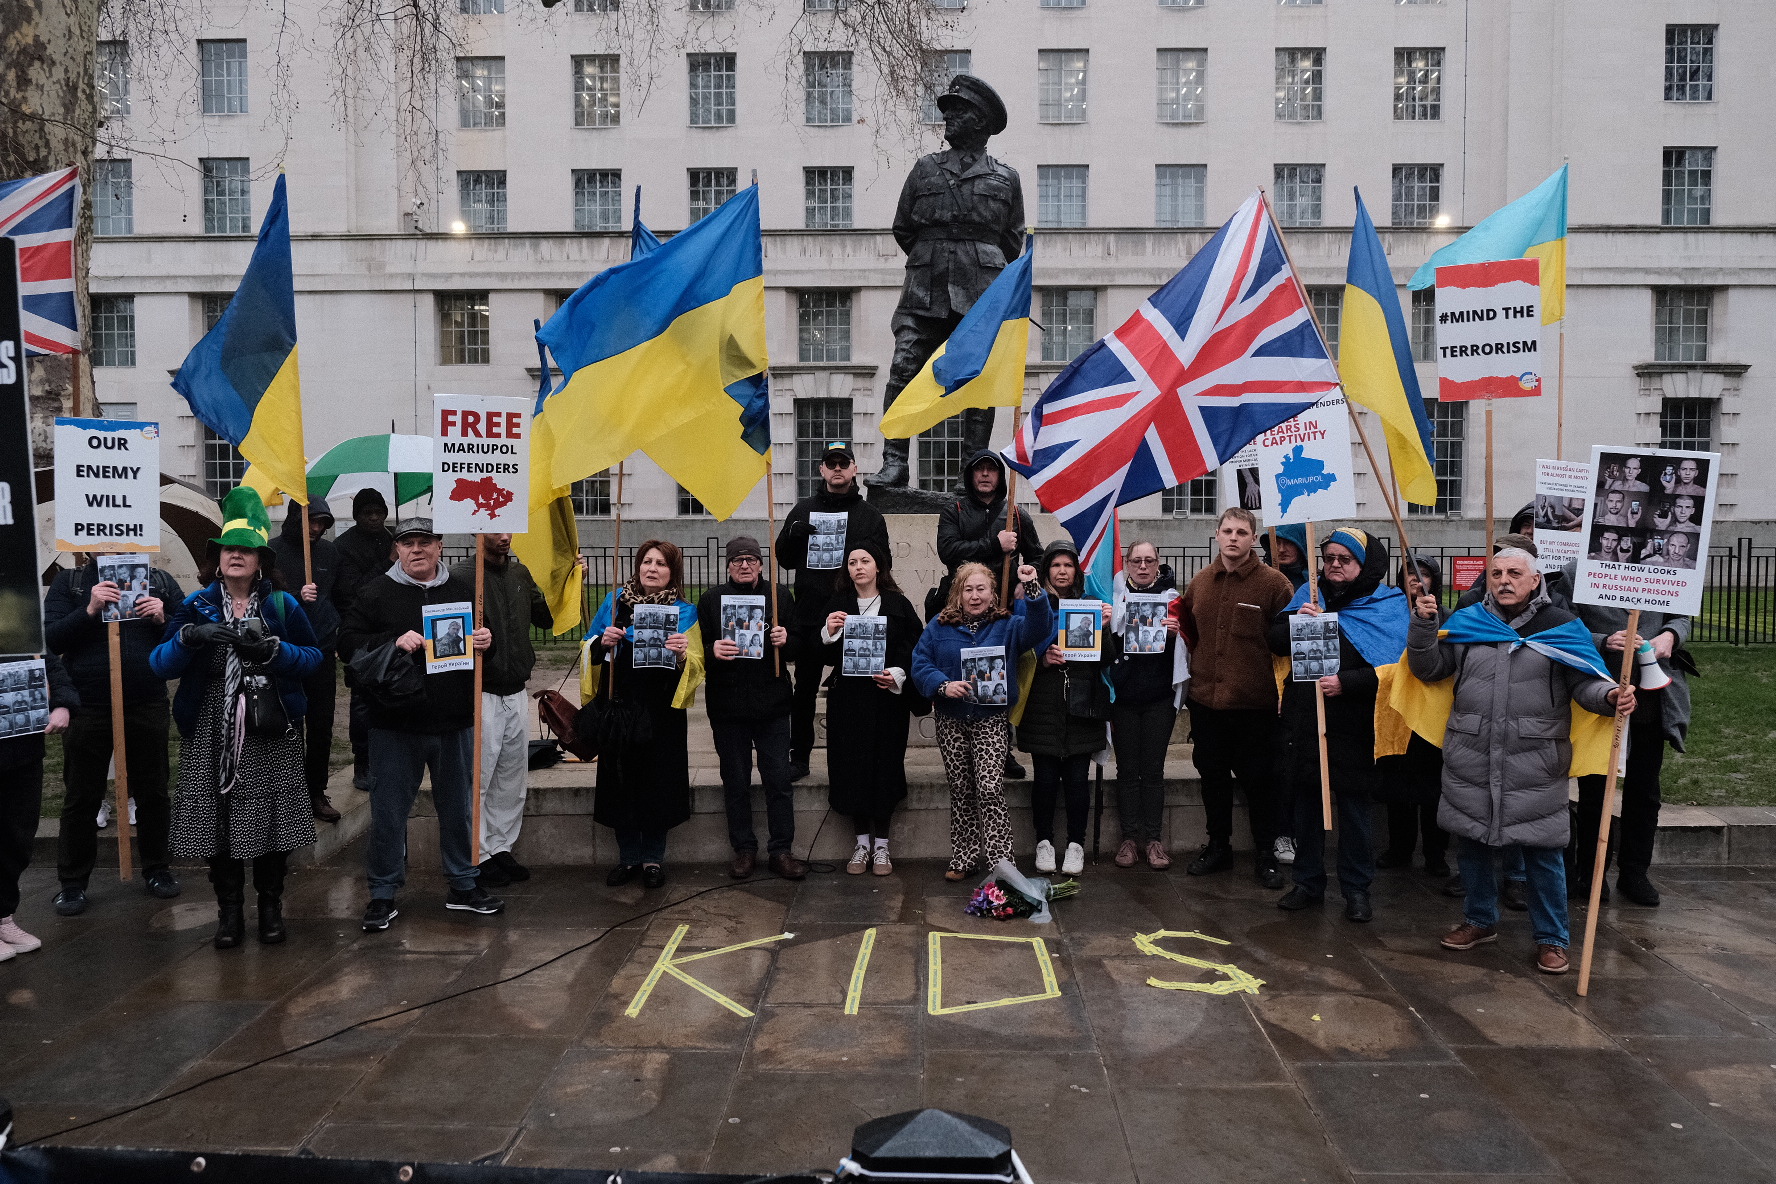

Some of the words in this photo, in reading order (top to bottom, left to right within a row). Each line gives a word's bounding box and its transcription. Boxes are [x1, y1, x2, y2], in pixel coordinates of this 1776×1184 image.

[1439, 308, 1497, 324] #MIND
[1502, 305, 1534, 320] THE
[1440, 340, 1537, 358] TERRORISM
[440, 409, 522, 440] FREE
[1304, 420, 1318, 431] IN
[88, 435, 129, 451] OUR
[1262, 429, 1327, 448] CAPTIVITY
[443, 442, 517, 455] MARIUPOL
[75, 464, 141, 480] ENEMY
[441, 461, 519, 474] DEFENDERS
[1287, 475, 1323, 486] MARIUPOL
[85, 493, 132, 508] WILL
[74, 522, 143, 537] PERISH!
[1600, 562, 1621, 571] THAT
[1624, 564, 1645, 573] HOW
[1647, 566, 1677, 576] LOOKS
[1587, 571, 1619, 580] PEOPLE
[1620, 574, 1642, 583] WHO
[1644, 577, 1687, 588] SURVIVED
[1602, 583, 1639, 593] RUSSIAN
[1641, 587, 1680, 598] PRISONS
[1597, 593, 1617, 601] AND
[1619, 596, 1642, 604] BACK
[1644, 598, 1671, 607] HOME
